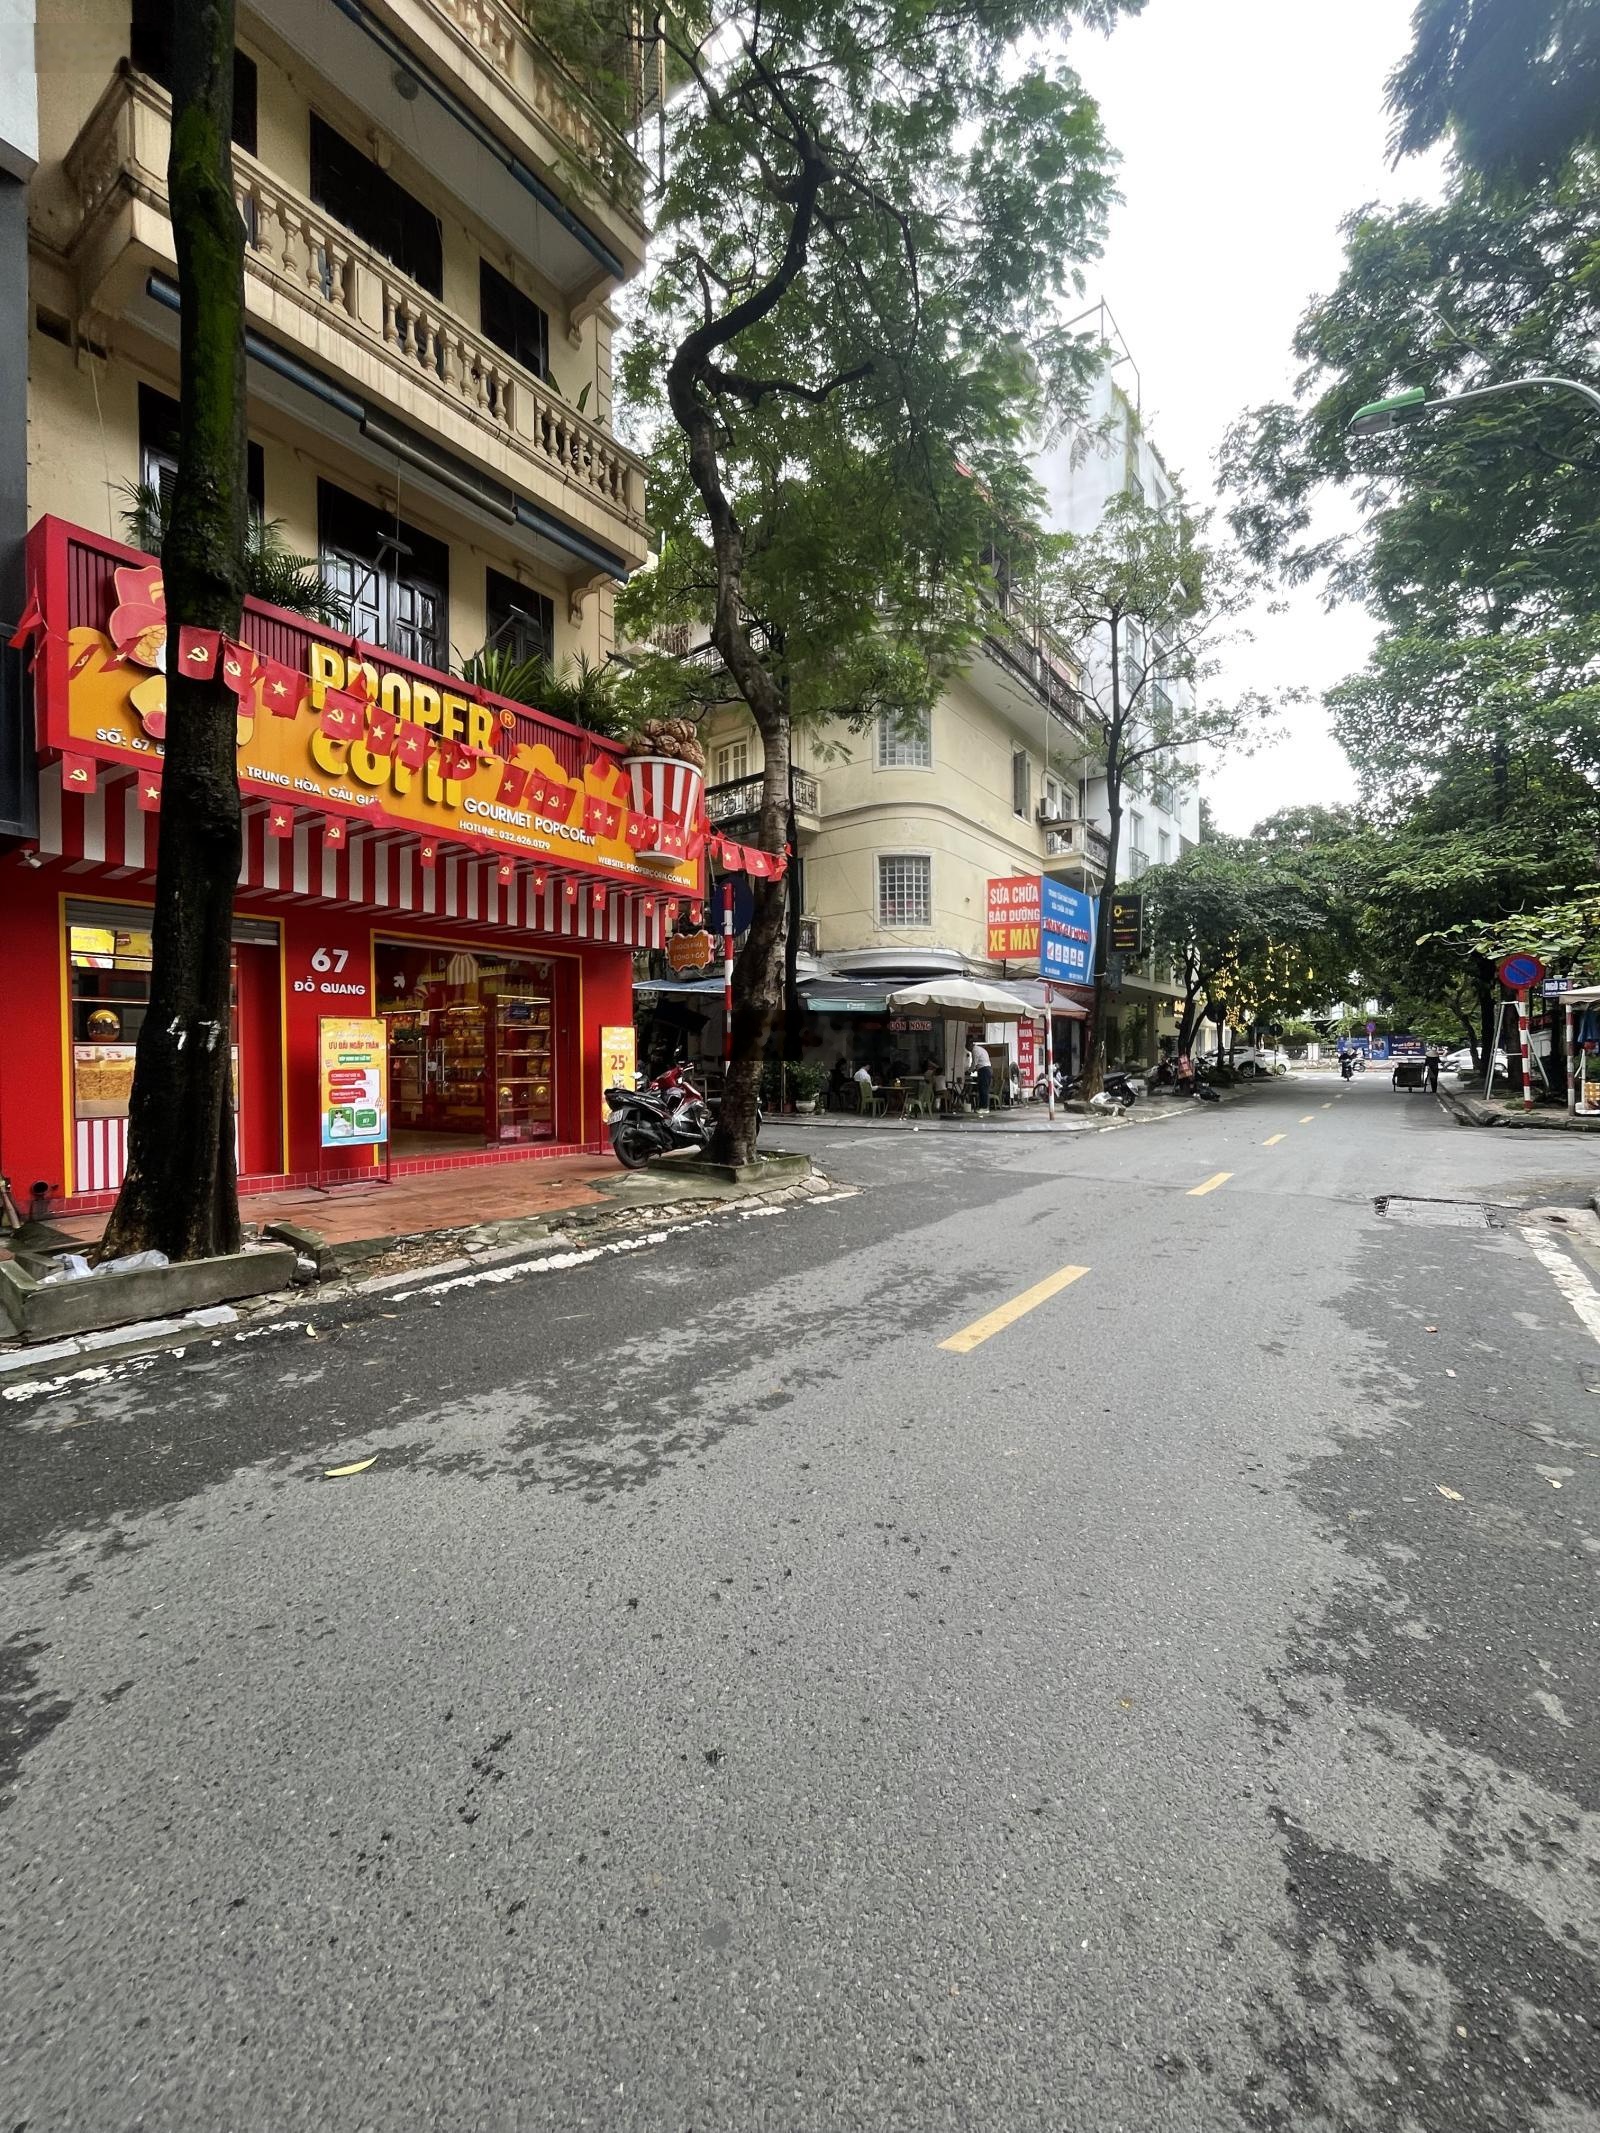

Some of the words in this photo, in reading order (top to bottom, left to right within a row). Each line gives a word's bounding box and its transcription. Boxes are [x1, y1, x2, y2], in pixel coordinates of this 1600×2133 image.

[96, 727, 126, 746] SỐ:
[131, 737, 150, 751] 67
[246, 765, 290, 786] TRUNG
[294, 776, 326, 796] HÒA,
[328, 785, 353, 801] CẦU
[459, 820, 498, 837] HOTLINE:
[499, 829, 551, 850] 032.626.0179
[463, 797, 533, 828] GOURMET
[534, 815, 597, 846] POPCORN
[597, 855, 626, 869] WEBSITE:
[626, 863, 692, 887] PROPERCORN.COM.VN
[990, 882, 1010, 904] SỬA
[1012, 882, 1039, 904] CHỮA
[988, 907, 1007, 922] BẢO
[1009, 906, 1041, 922] DƯỠNG
[989, 929, 1006, 951] XE
[1009, 924, 1039, 951] MÁY
[311, 947, 349, 973] 67
[294, 975, 315, 992] ĐỖ
[320, 982, 366, 995] QUANG
